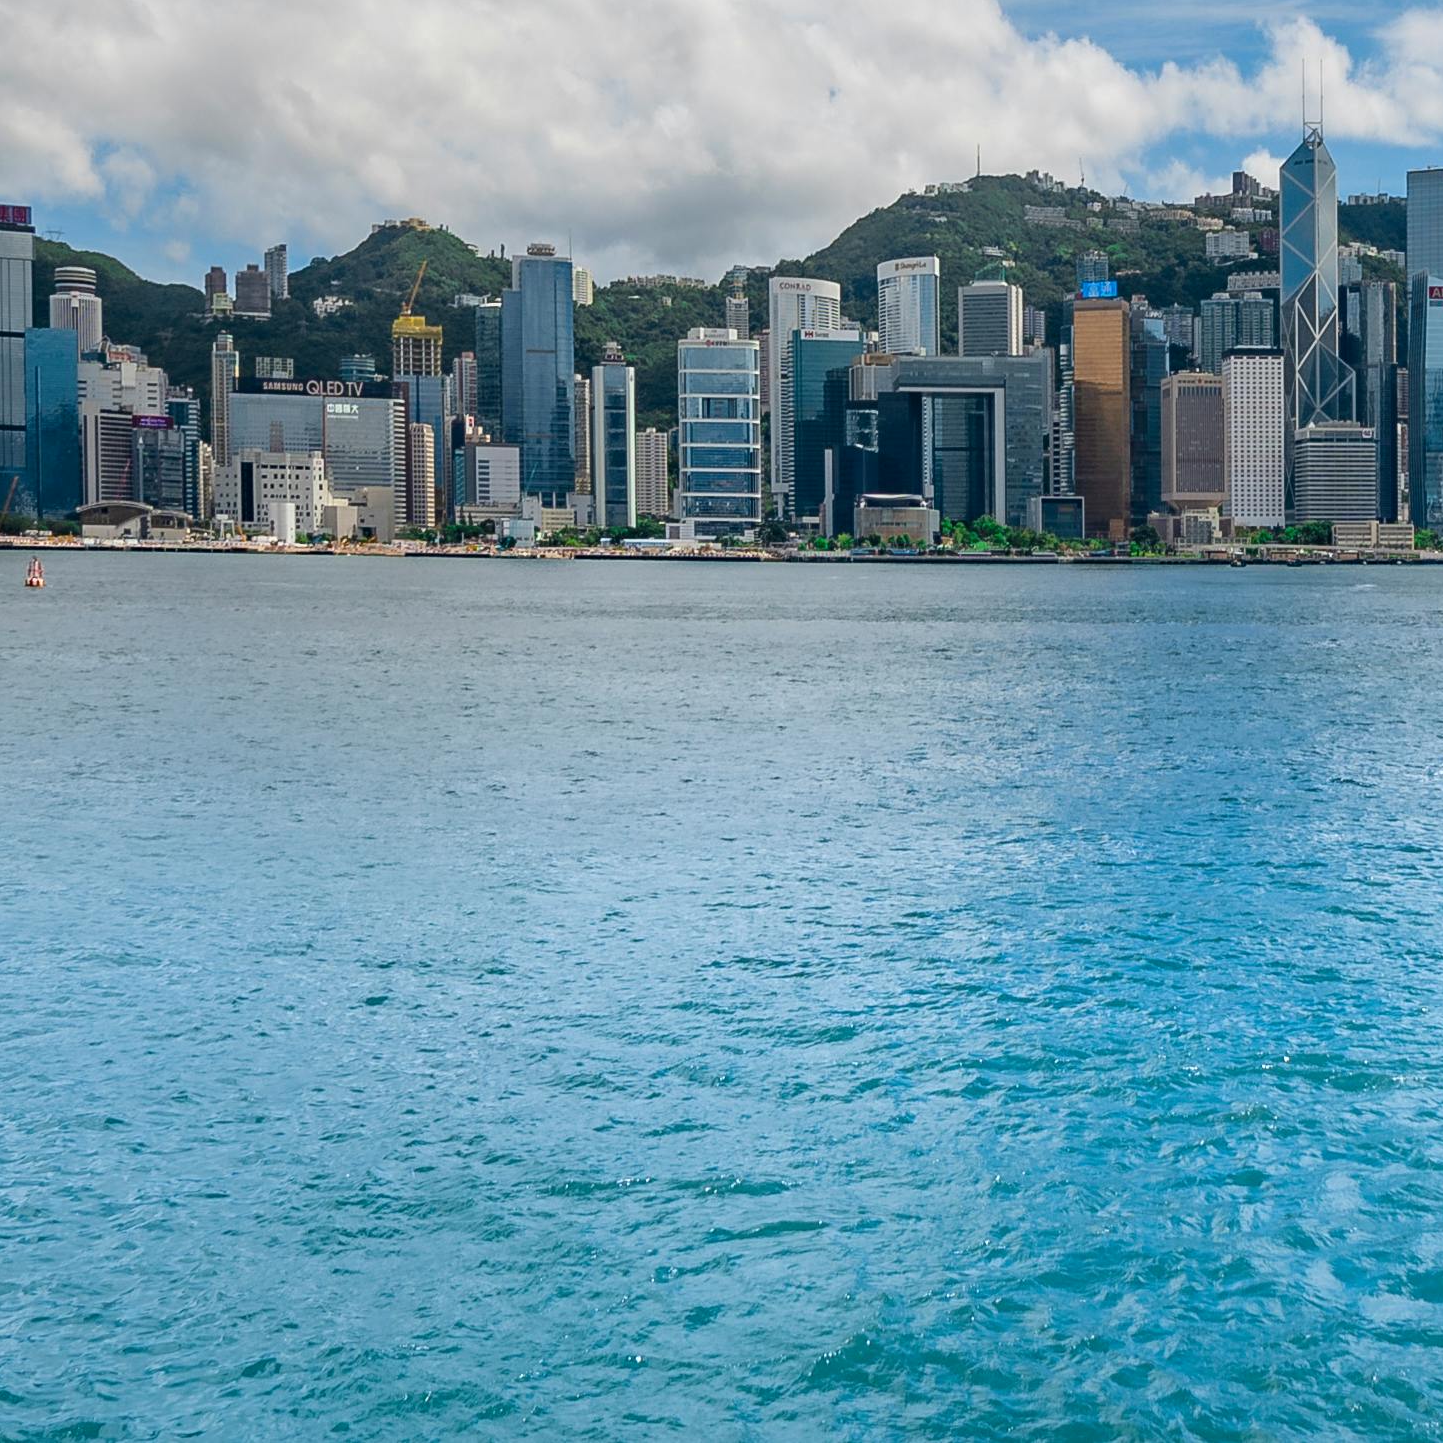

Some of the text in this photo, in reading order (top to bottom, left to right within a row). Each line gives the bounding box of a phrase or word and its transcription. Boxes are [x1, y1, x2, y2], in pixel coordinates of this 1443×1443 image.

[779, 282, 811, 292] CONRAD
[263, 380, 364, 396] SAMSUNG QLED TV
